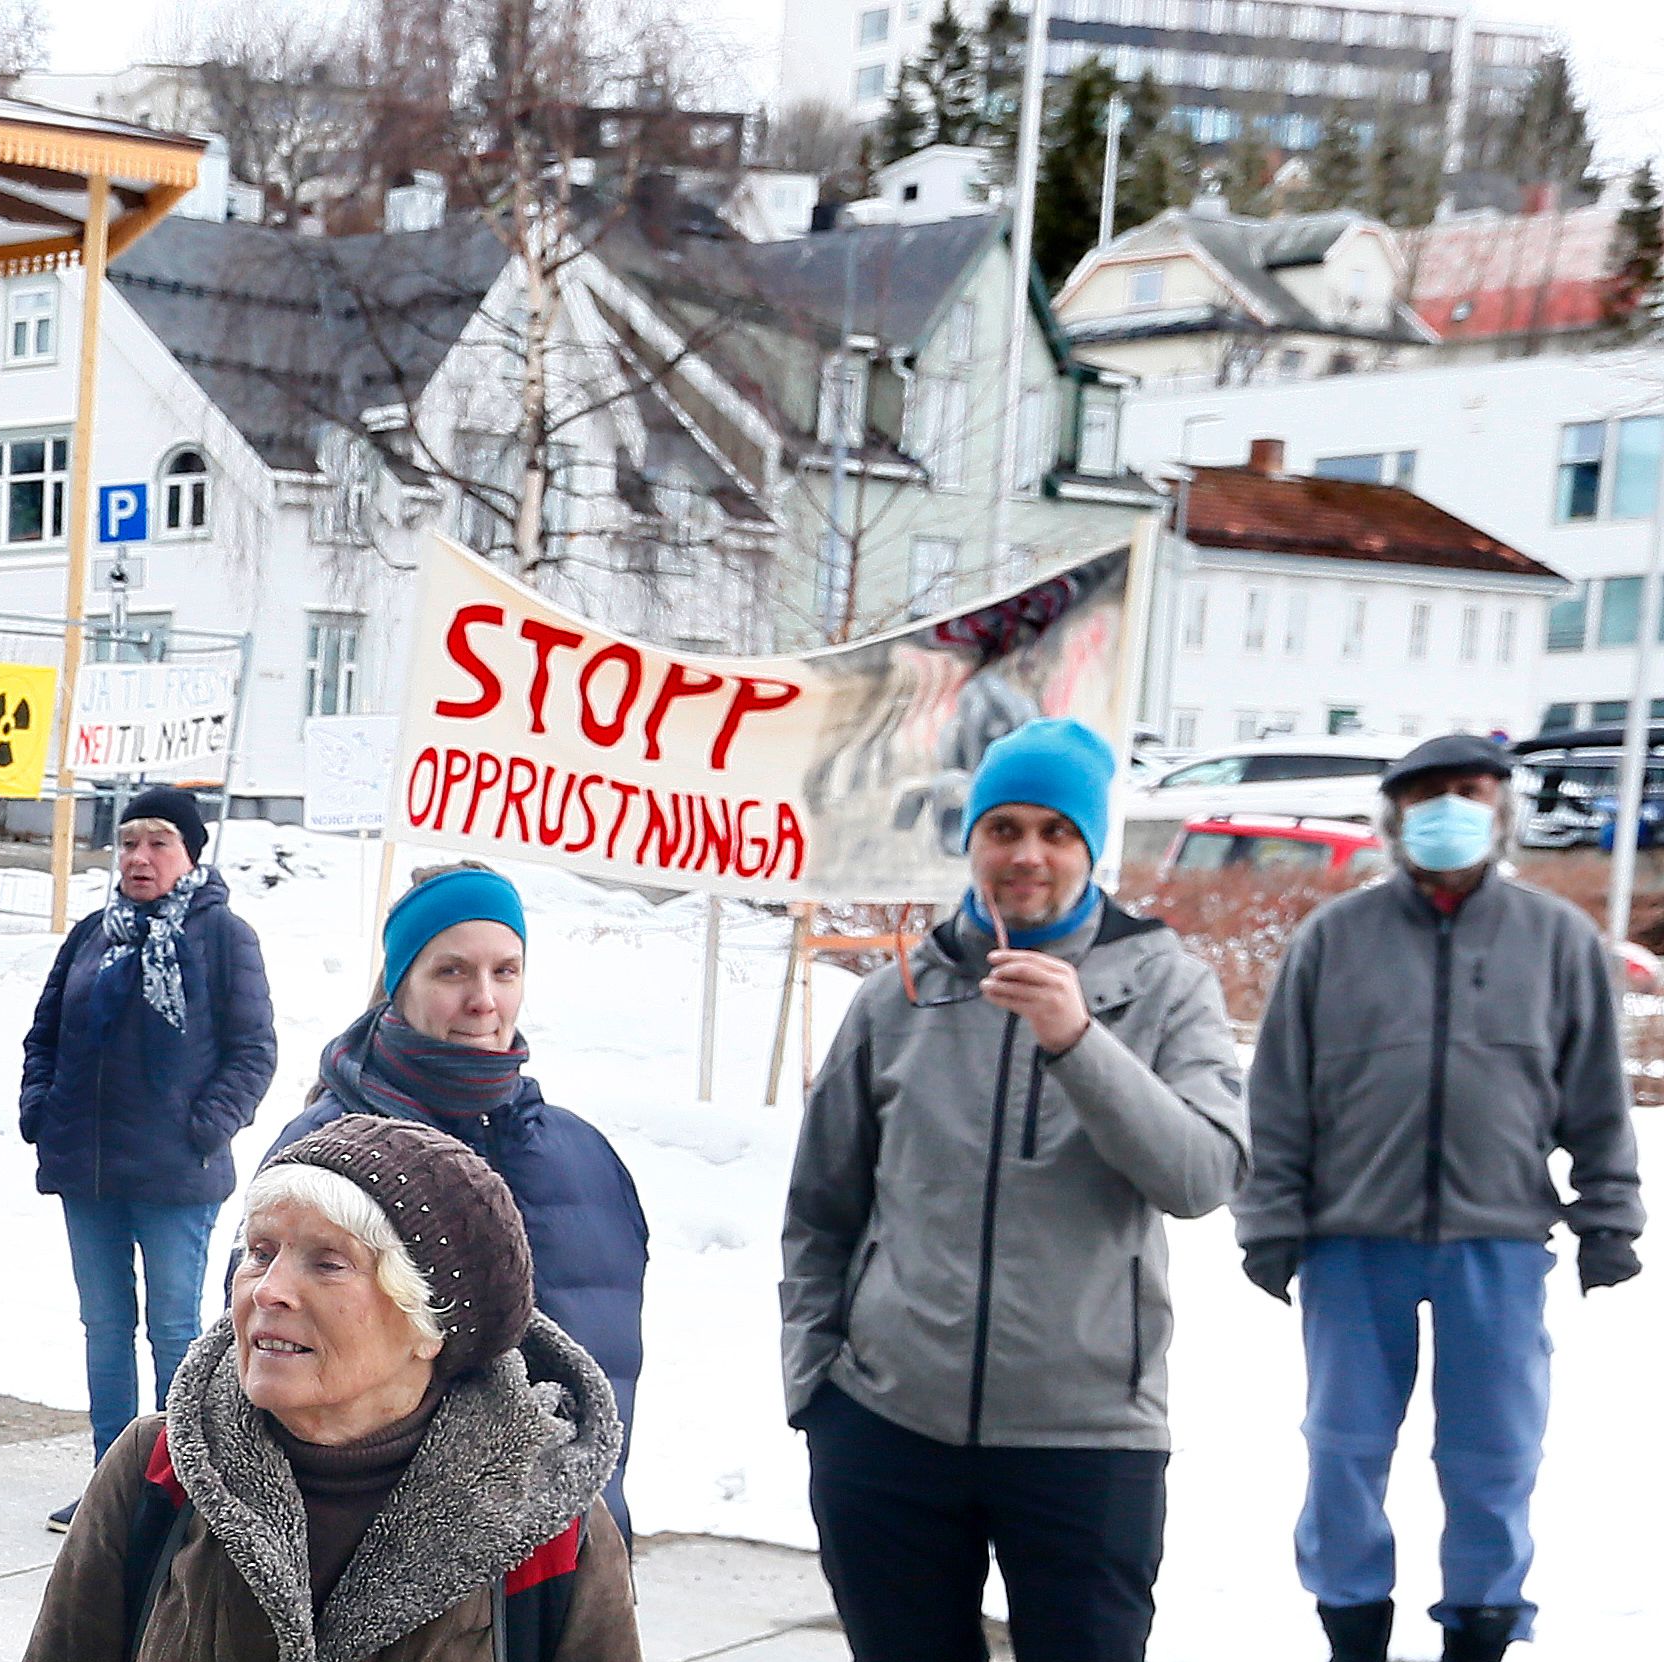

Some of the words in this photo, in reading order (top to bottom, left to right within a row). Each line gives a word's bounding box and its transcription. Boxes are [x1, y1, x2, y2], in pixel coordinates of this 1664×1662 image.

[108, 490, 138, 538] P
[435, 604, 801, 770] STOPP
[74, 724, 113, 765] NEI
[116, 725, 146, 765] TIL
[407, 747, 806, 881] OPPRUSTNINGA
